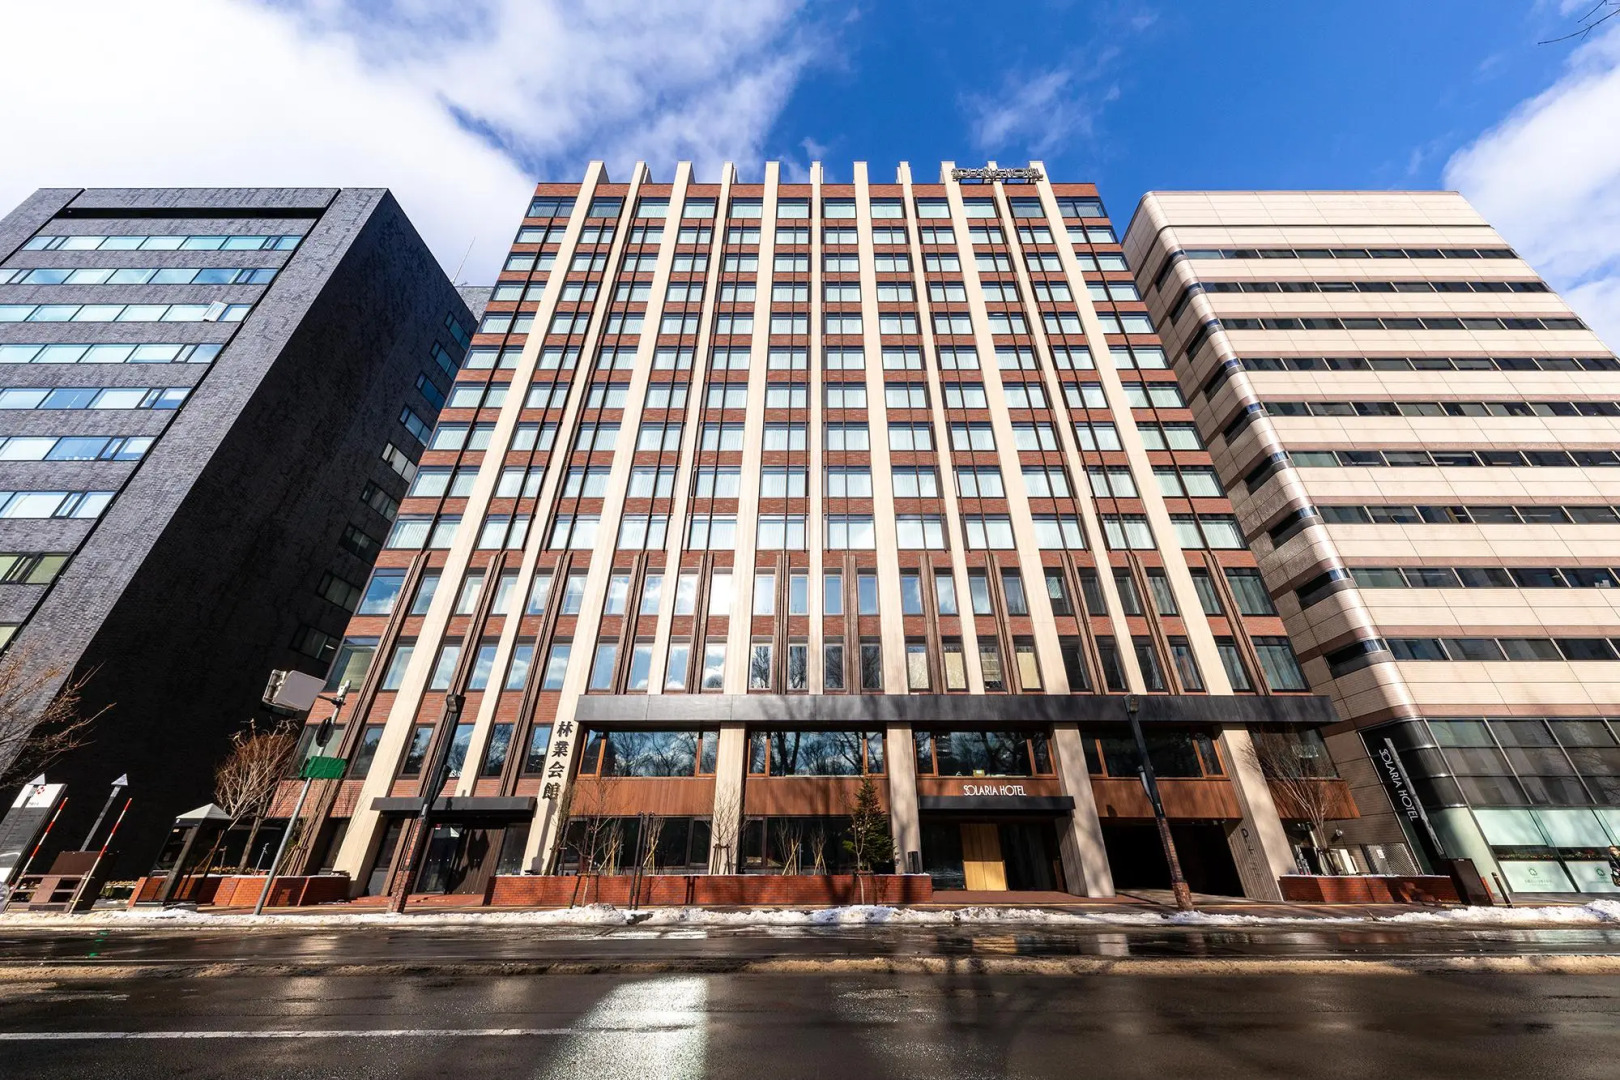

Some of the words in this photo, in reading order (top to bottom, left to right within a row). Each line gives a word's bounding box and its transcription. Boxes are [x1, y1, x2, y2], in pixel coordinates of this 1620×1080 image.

[542, 721, 573, 800] 林業会館
[963, 785, 998, 796] SOLARIA
[999, 785, 1026, 796] HOTEL
[1379, 748, 1402, 788] SOLARIA
[1398, 790, 1418, 821] HOTEL
